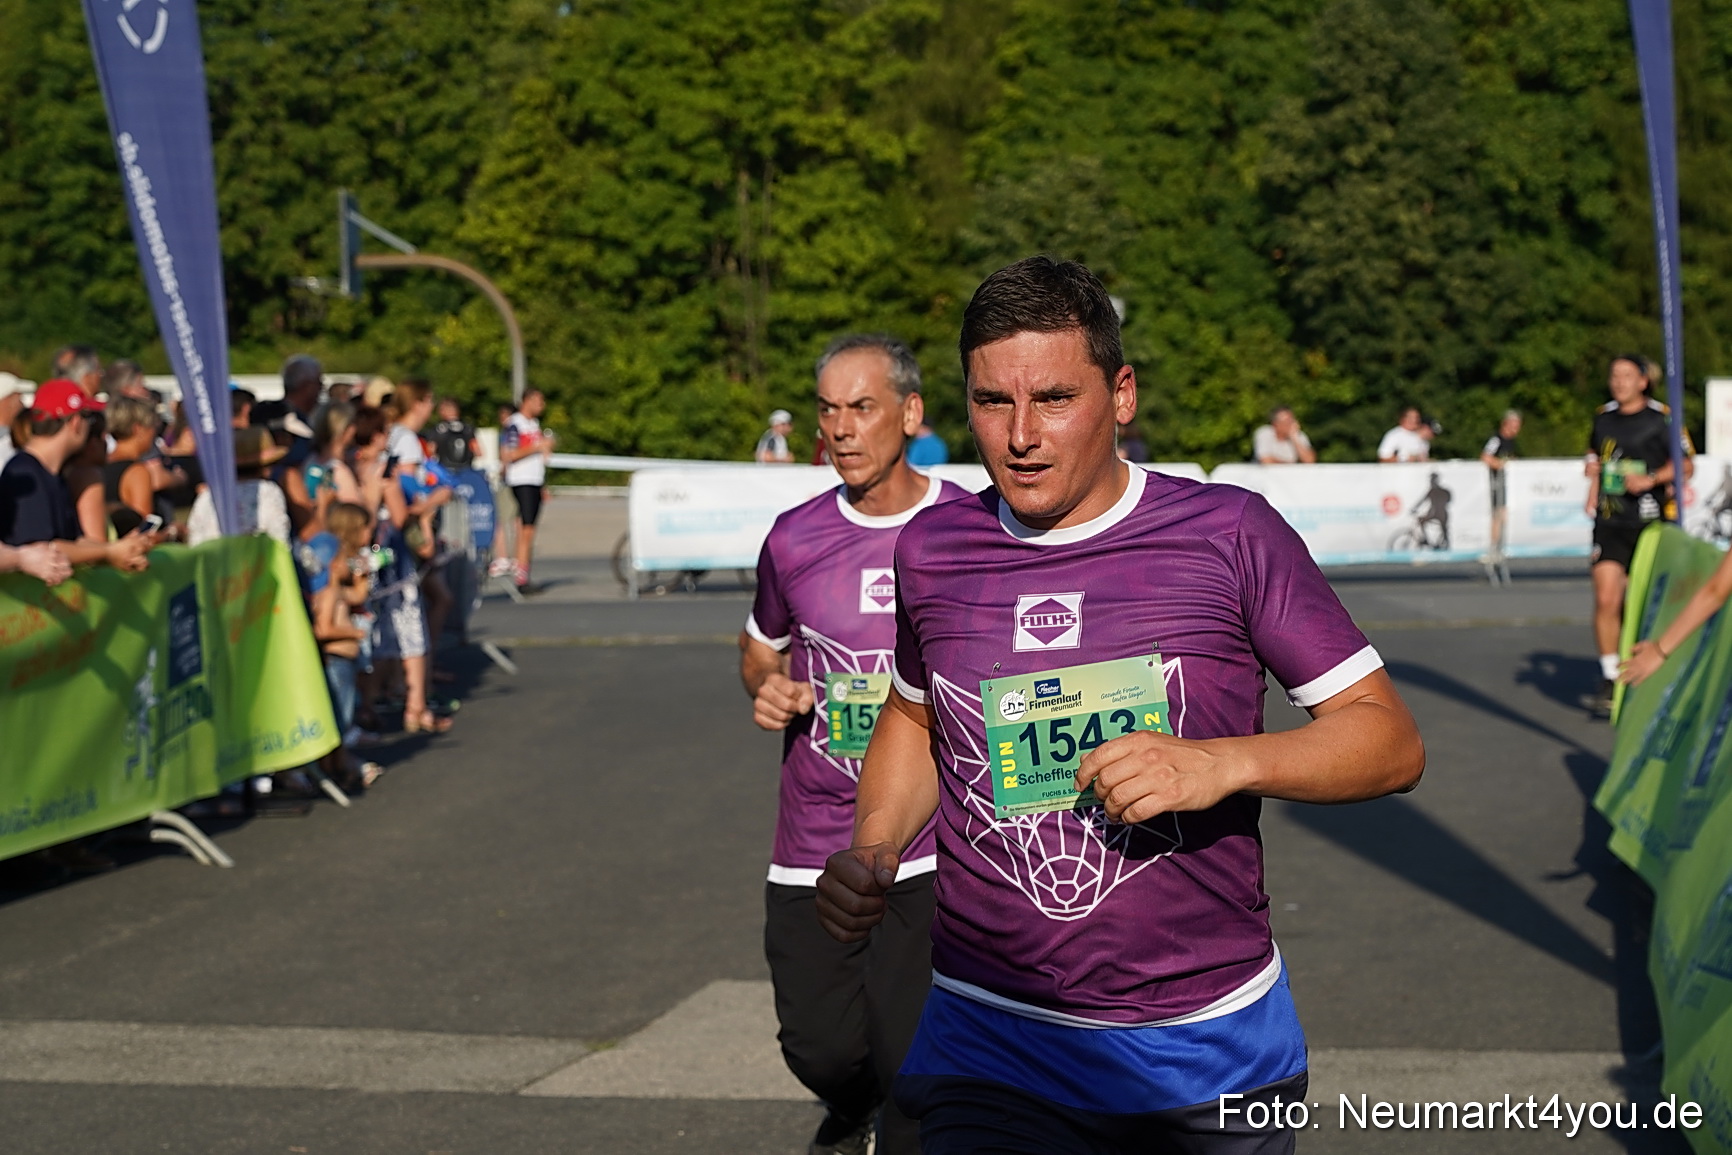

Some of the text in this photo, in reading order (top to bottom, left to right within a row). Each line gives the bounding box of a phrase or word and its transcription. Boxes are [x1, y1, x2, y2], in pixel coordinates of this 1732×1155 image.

[865, 585, 894, 596] FUCH
[1020, 613, 1078, 627] FUCHS
[1029, 690, 1082, 711] Firmenlauf
[1050, 701, 1083, 713] neumarkt
[842, 704, 884, 730] 15
[1019, 709, 1136, 766] 1543
[999, 741, 1019, 789] RUN
[1042, 789, 1062, 798] FUCHS
